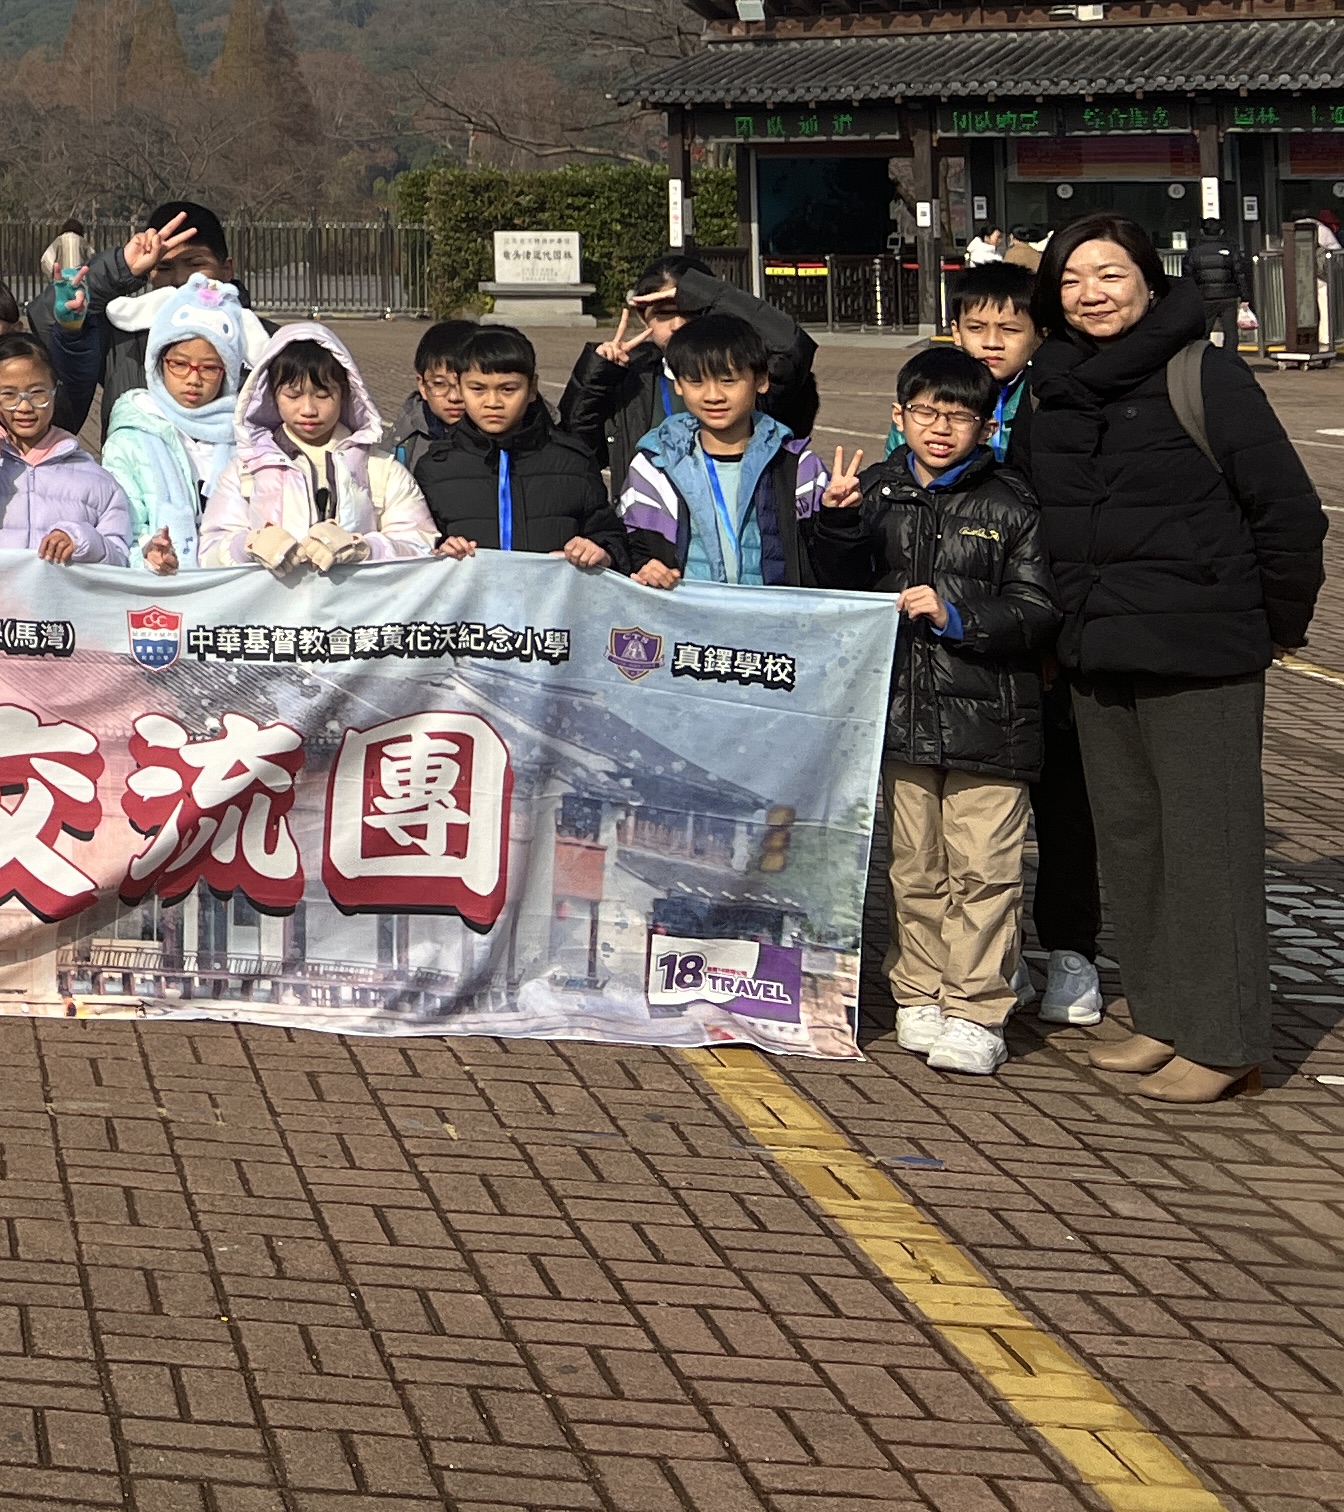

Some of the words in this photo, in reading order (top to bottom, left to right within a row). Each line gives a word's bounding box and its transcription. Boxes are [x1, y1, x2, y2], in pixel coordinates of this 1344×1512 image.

[673, 643, 795, 690] 真鐸學校
[657, 952, 706, 993] 18
[706, 973, 793, 1004] TRAVEL
